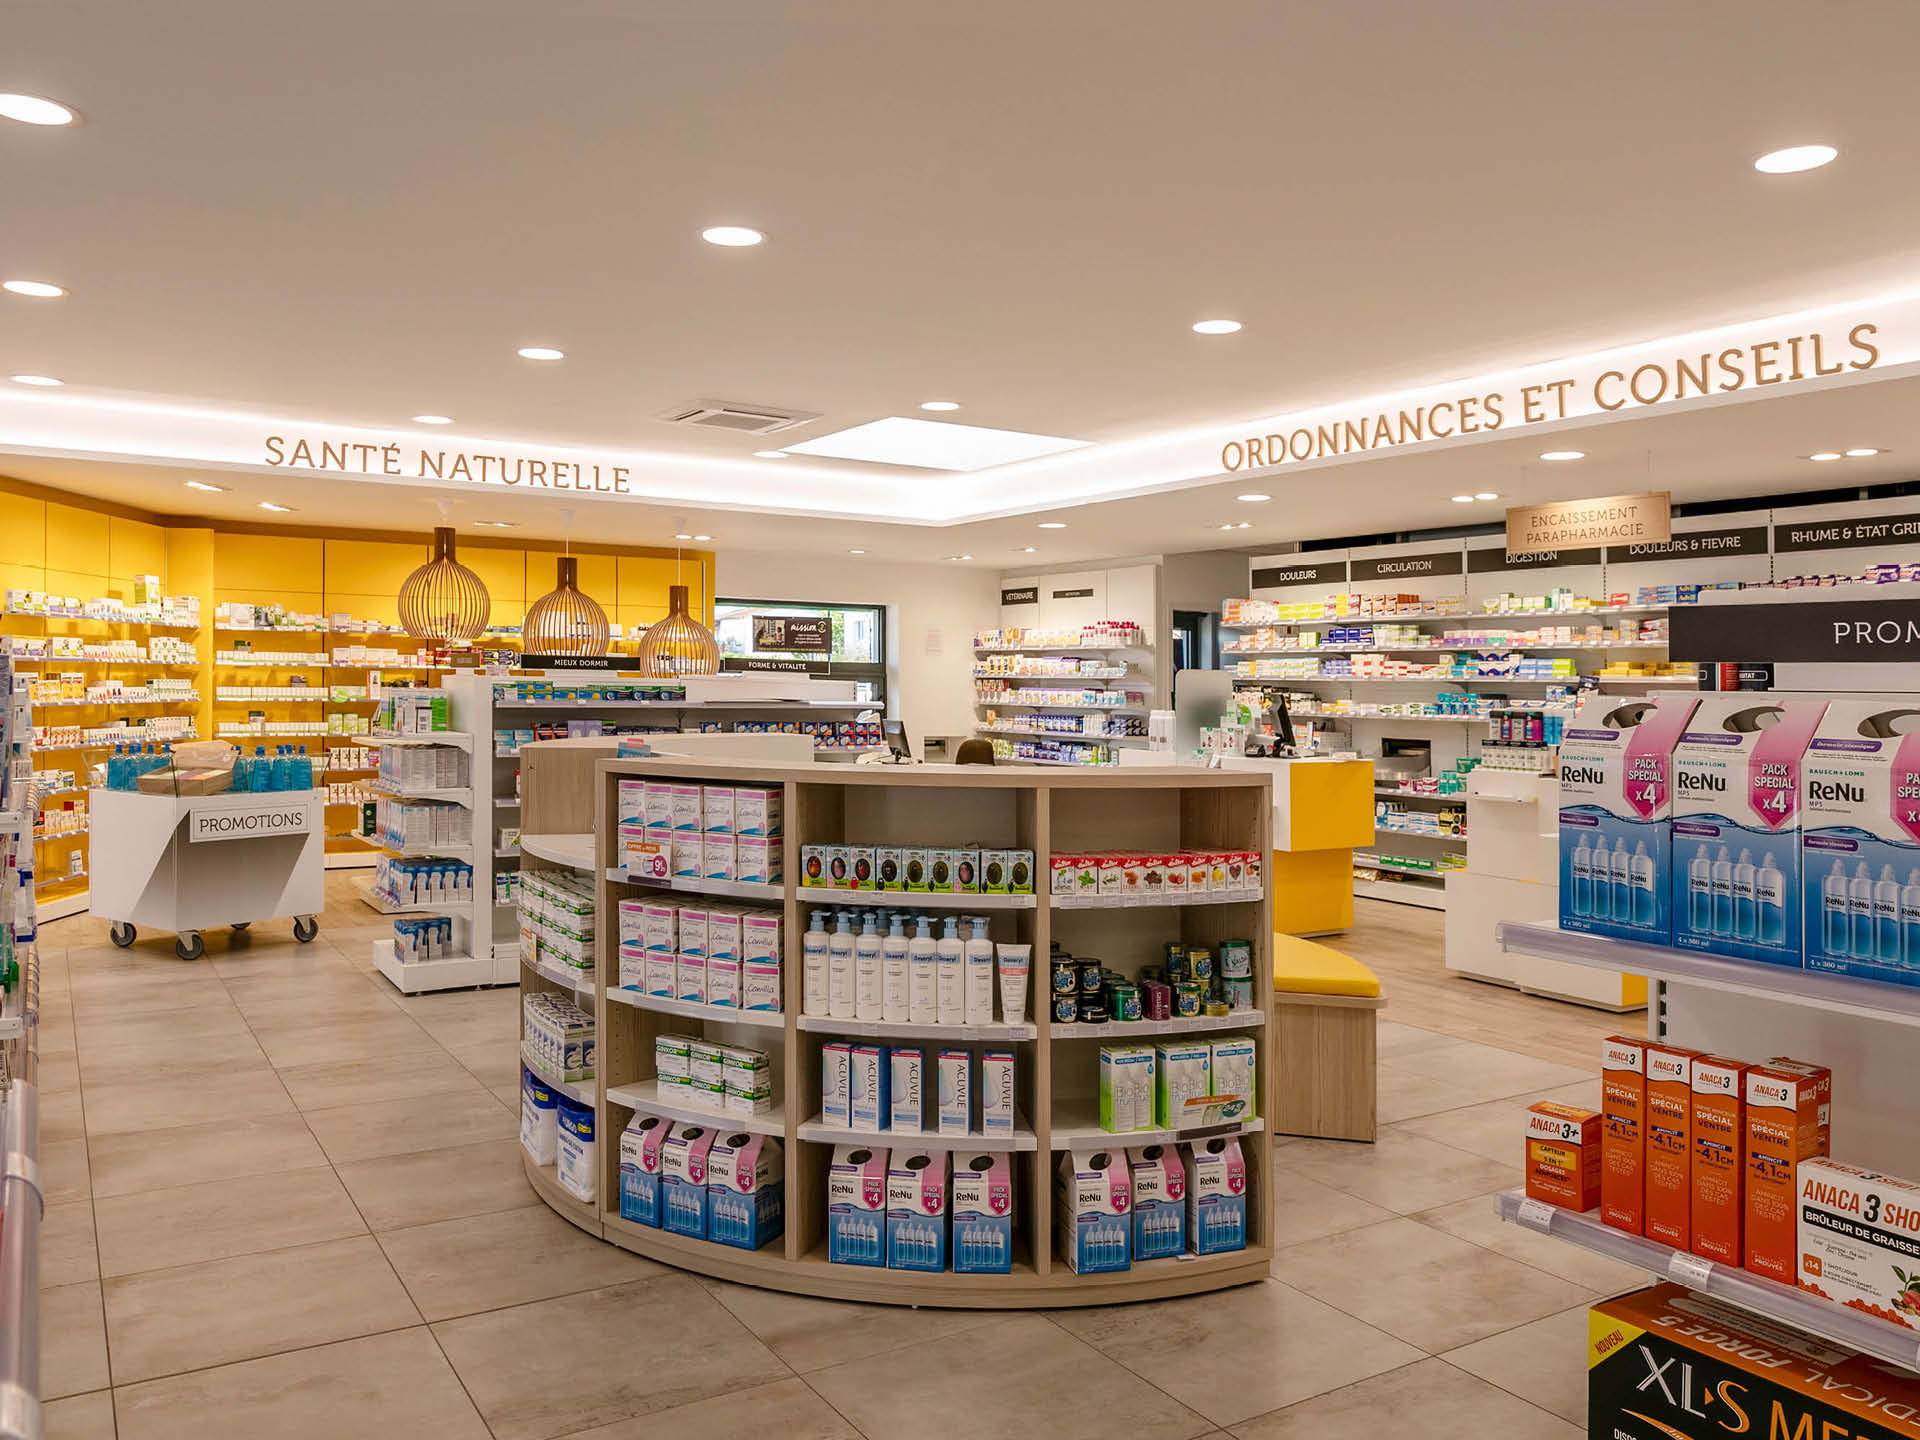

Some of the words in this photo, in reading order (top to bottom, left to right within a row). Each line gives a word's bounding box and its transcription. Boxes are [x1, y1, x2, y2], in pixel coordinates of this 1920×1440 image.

[1222, 393, 1504, 472] ORDONNANCES
[1520, 378, 1577, 423] ET
[1593, 323, 1880, 411] CONSEILS
[264, 435, 401, 476] SANTÉ
[418, 449, 631, 494] NATURELLE
[1530, 506, 1638, 528] ENCAISSEMENT
[1526, 522, 1644, 545] PARAPHARMACIE
[1791, 528, 1839, 543] RHUME
[1842, 528, 1851, 539] &
[1855, 524, 1889, 538] ÉTAT
[1629, 540, 1689, 554] DOULEURS
[1690, 540, 1699, 550] &
[1702, 536, 1741, 550] FIEVRE
[1505, 549, 1558, 563] DIGESTION
[1377, 561, 1432, 574] CIRCULATION
[1280, 570, 1317, 582] DOULEURS
[554, 659, 578, 667] MIEUX
[579, 659, 608, 667] DORMIR
[748, 661, 771, 669] FORME
[1635, 758, 1657, 769] PACK
[1762, 763, 1788, 775] PACK
[1561, 765, 1604, 784] ReNu
[1628, 770, 1663, 783] SPECIAL
[1678, 771, 1726, 792] ReNu
[1754, 776, 1795, 790] SPECIAL
[1809, 780, 1865, 802] ReNu
[199, 812, 303, 833] PROMOTIONS
[1691, 878, 1708, 888] ReNu
[1712, 881, 1729, 890] ReNu
[1733, 883, 1751, 893] ReNu
[1757, 888, 1775, 898] ReNu
[1825, 896, 1845, 906] ReNu
[1849, 900, 1870, 910] ReNu
[1874, 902, 1895, 913] ReNu
[1607, 1049, 1629, 1062] ANACA
[1629, 1053, 1636, 1065] 3
[1653, 1059, 1676, 1073] ANACA
[1675, 1063, 1683, 1075] 3
[838, 1055, 847, 1099] ACUVUE
[867, 1059, 877, 1104] ACUVUE
[909, 1061, 919, 1105] ACUVUE
[1699, 1072, 1722, 1086] ANACA
[1723, 1076, 1730, 1089] 3
[957, 1064, 966, 1109] ACUVUE
[1001, 1065, 1012, 1110] ACUVUE
[1754, 1084, 1779, 1098] ANACA
[1780, 1088, 1788, 1101] 3
[1607, 1095, 1637, 1108] VENTRE
[1652, 1106, 1683, 1120] VENTRE
[1529, 1117, 1560, 1135] ANACA
[1698, 1119, 1732, 1133] VENTRE
[1752, 1131, 1789, 1147] VENTRE
[622, 1144, 637, 1156] ReNu
[1540, 1145, 1566, 1157] CAPTEUR
[664, 1155, 682, 1167] ReNu
[710, 1165, 729, 1176] ReNu
[1137, 1181, 1158, 1191] ReNu
[1200, 1176, 1220, 1186] ReNu
[831, 1184, 854, 1194] ReNu
[889, 1189, 913, 1200] ReNu
[956, 1192, 979, 1201] ReNu
[1079, 1193, 1101, 1203] ReNu
[1803, 1178, 1860, 1214] ANACA
[1863, 1193, 1882, 1223] 3
[1805, 1210, 1854, 1235] BRÛLEUR
[1855, 1227, 1871, 1240] DE
[1594, 1328, 1625, 1356] NOUVEAU
